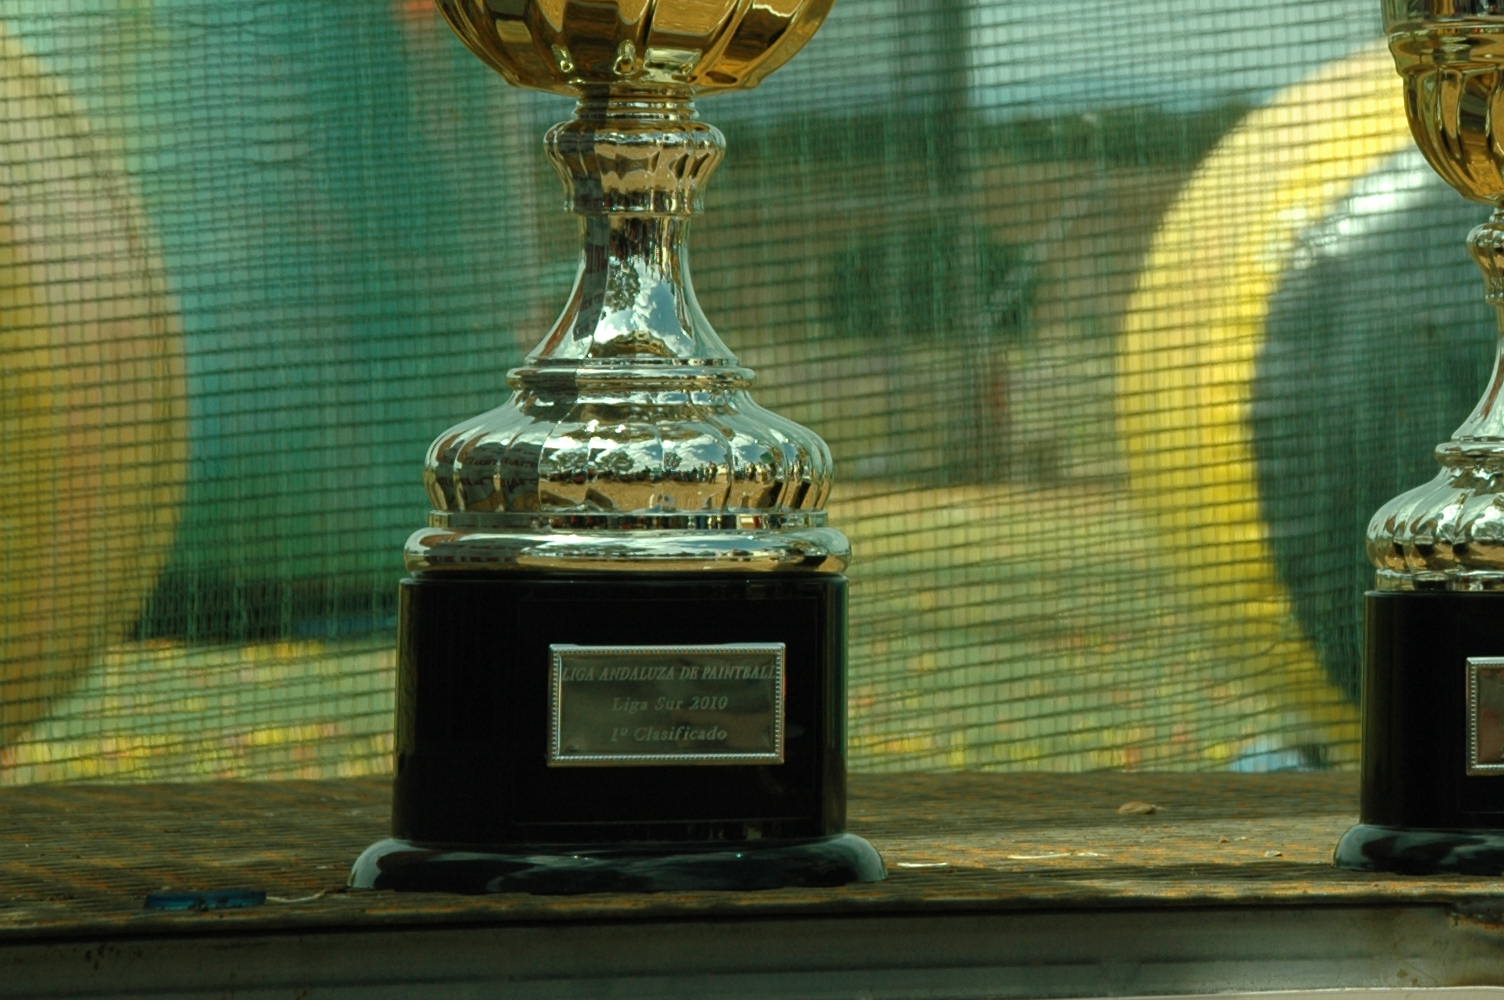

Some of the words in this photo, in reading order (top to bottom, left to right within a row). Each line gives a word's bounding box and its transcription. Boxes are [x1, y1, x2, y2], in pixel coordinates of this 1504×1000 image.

[599, 666, 675, 681] ANDALUZA
[679, 666, 698, 680] DE
[611, 697, 648, 715] Liga
[654, 697, 685, 712] Sur
[689, 696, 729, 711] 2010
[634, 726, 728, 742] Clasificado
